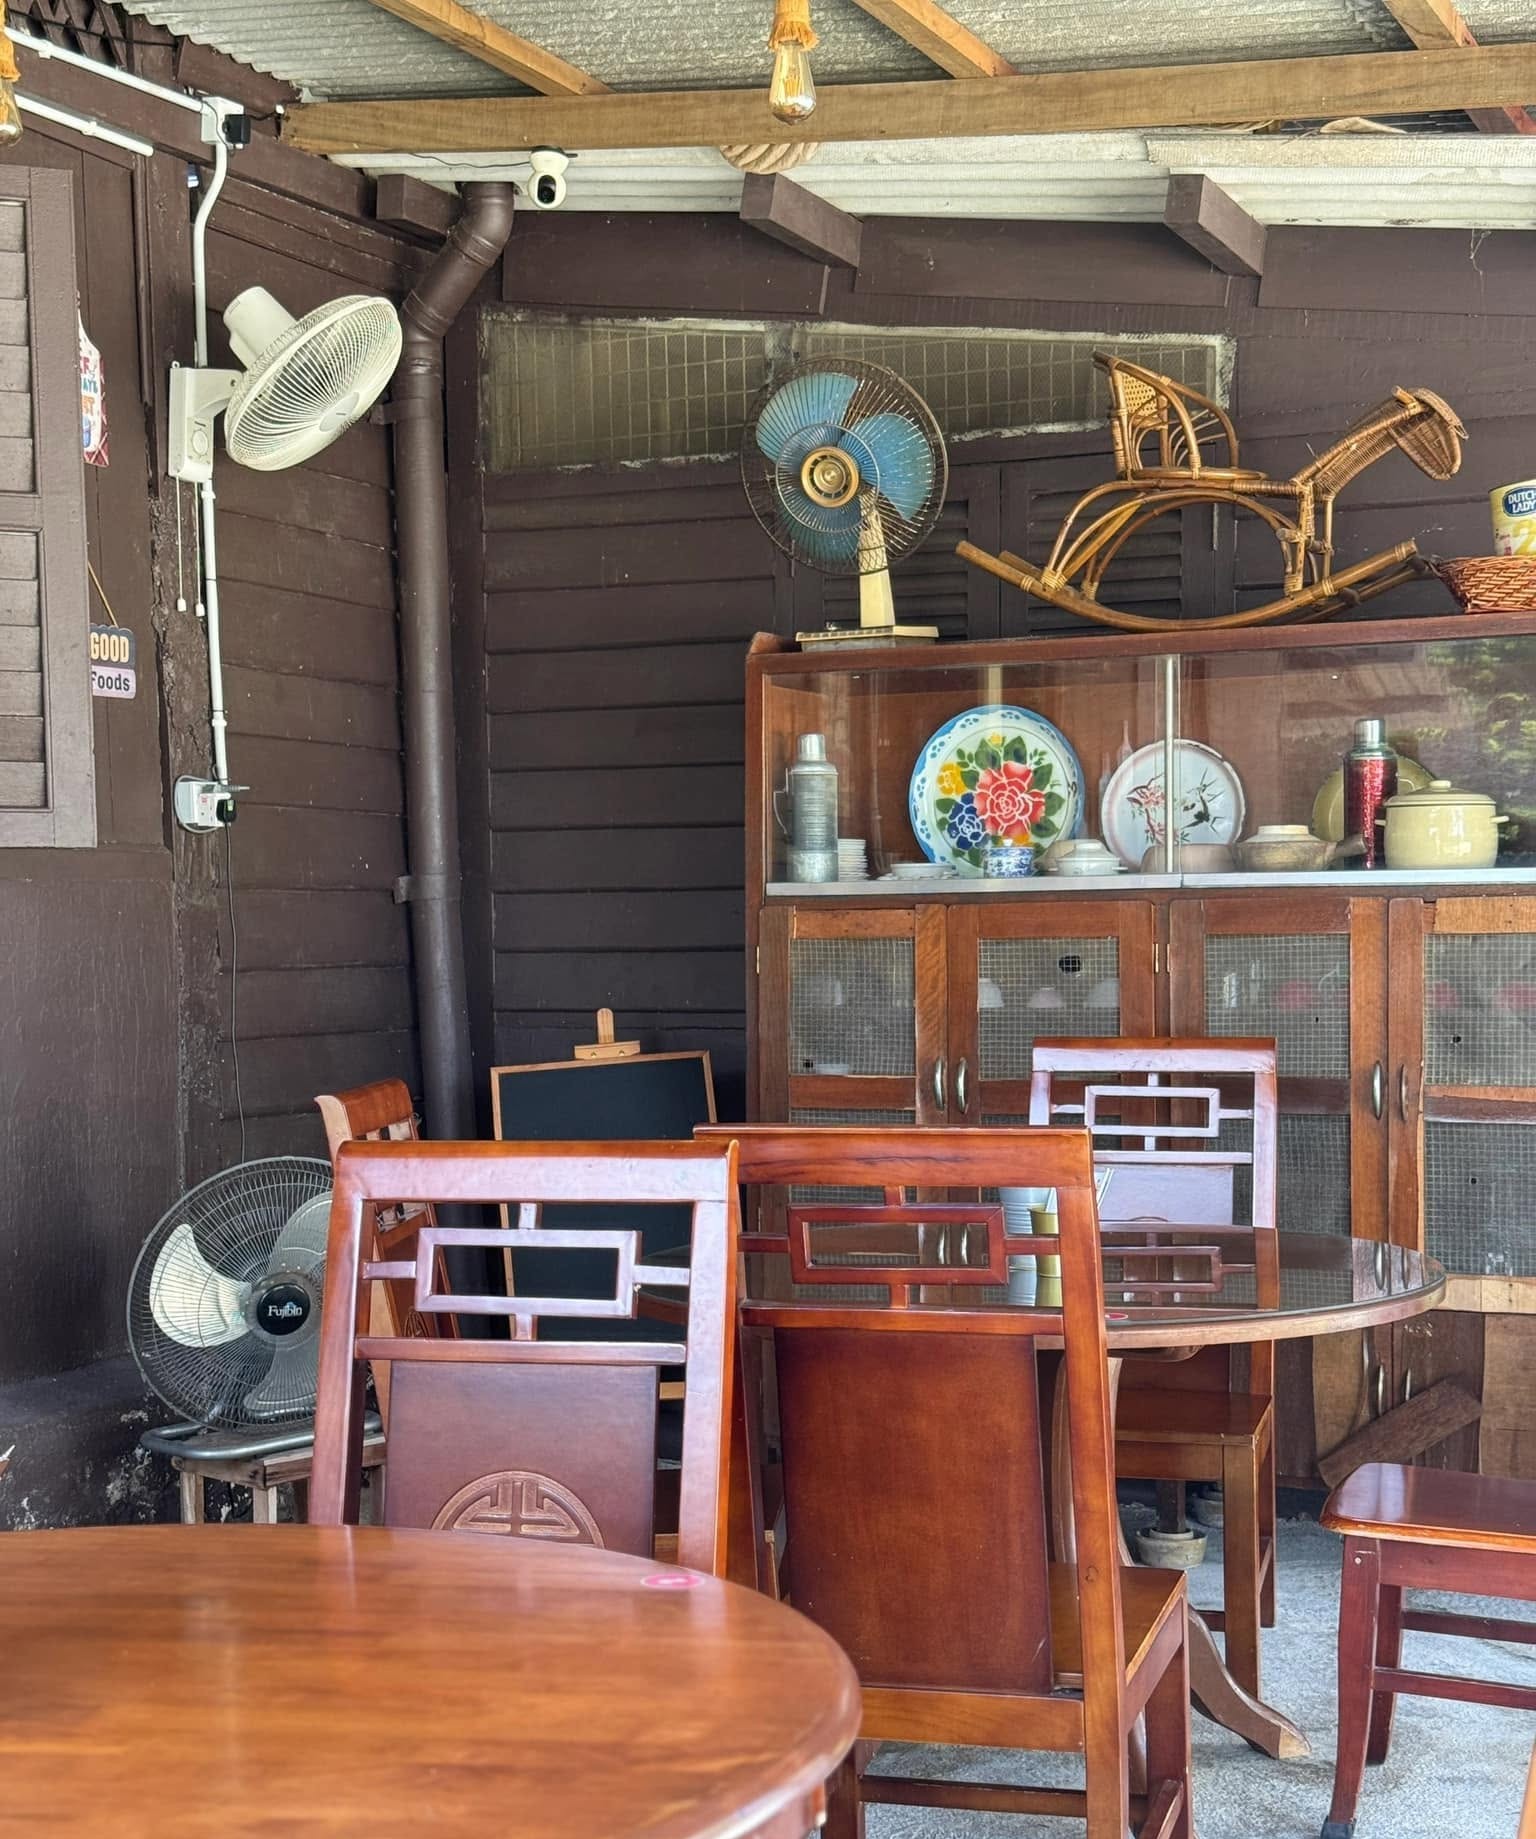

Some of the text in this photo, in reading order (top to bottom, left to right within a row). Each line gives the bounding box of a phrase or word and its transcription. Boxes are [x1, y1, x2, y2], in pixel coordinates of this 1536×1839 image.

[1508, 490, 1536, 505] DUTCH
[1512, 500, 1536, 513] LADY
[90, 631, 130, 663] GOOD
